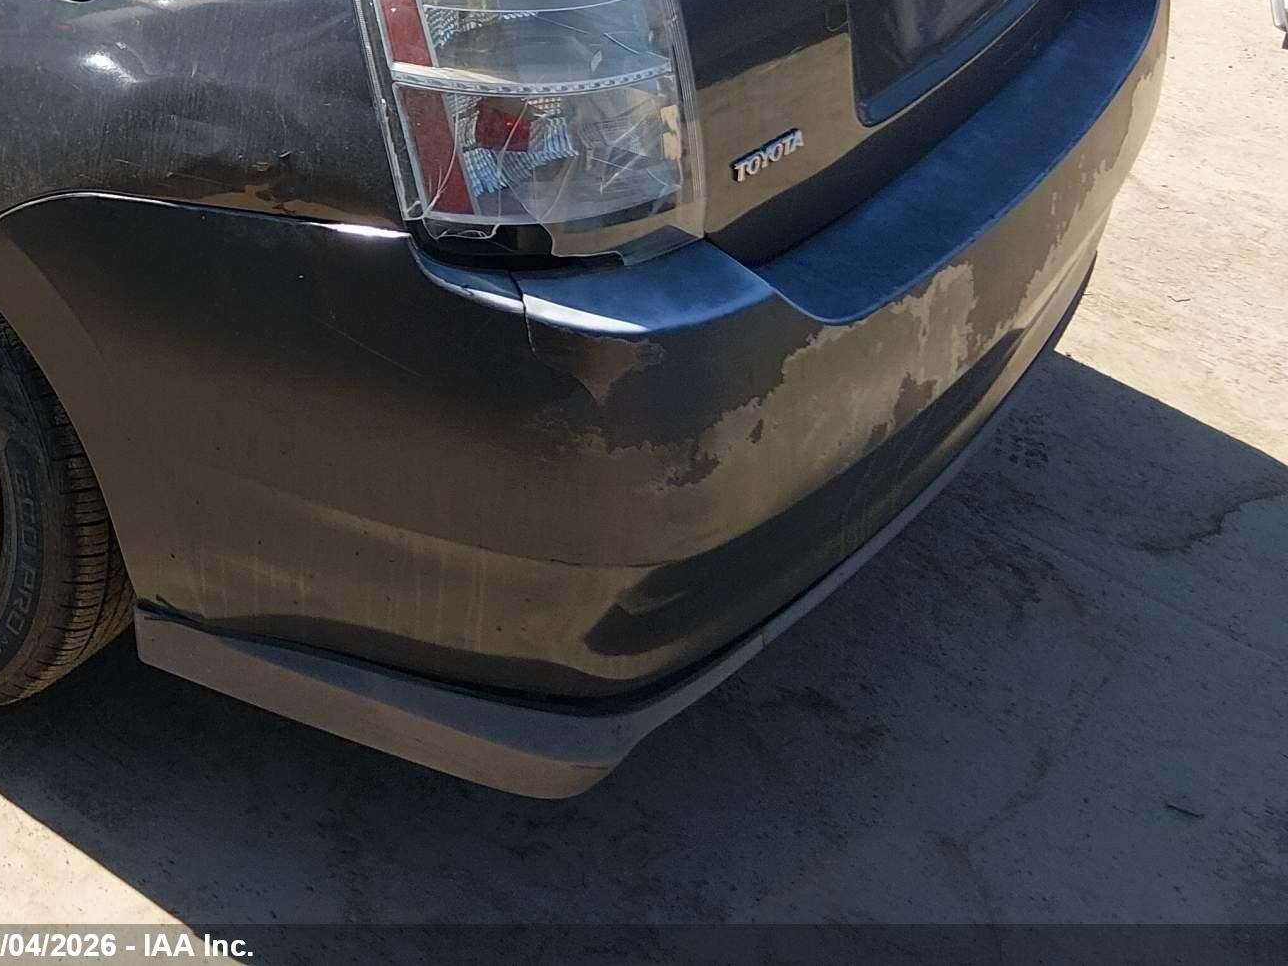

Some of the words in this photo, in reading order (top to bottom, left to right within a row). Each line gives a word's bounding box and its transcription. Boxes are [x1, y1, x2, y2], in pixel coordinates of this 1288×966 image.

[731, 128, 804, 182] TOYOTA
[14, 469, 38, 555] ECO
[5, 563, 37, 635] PRO
